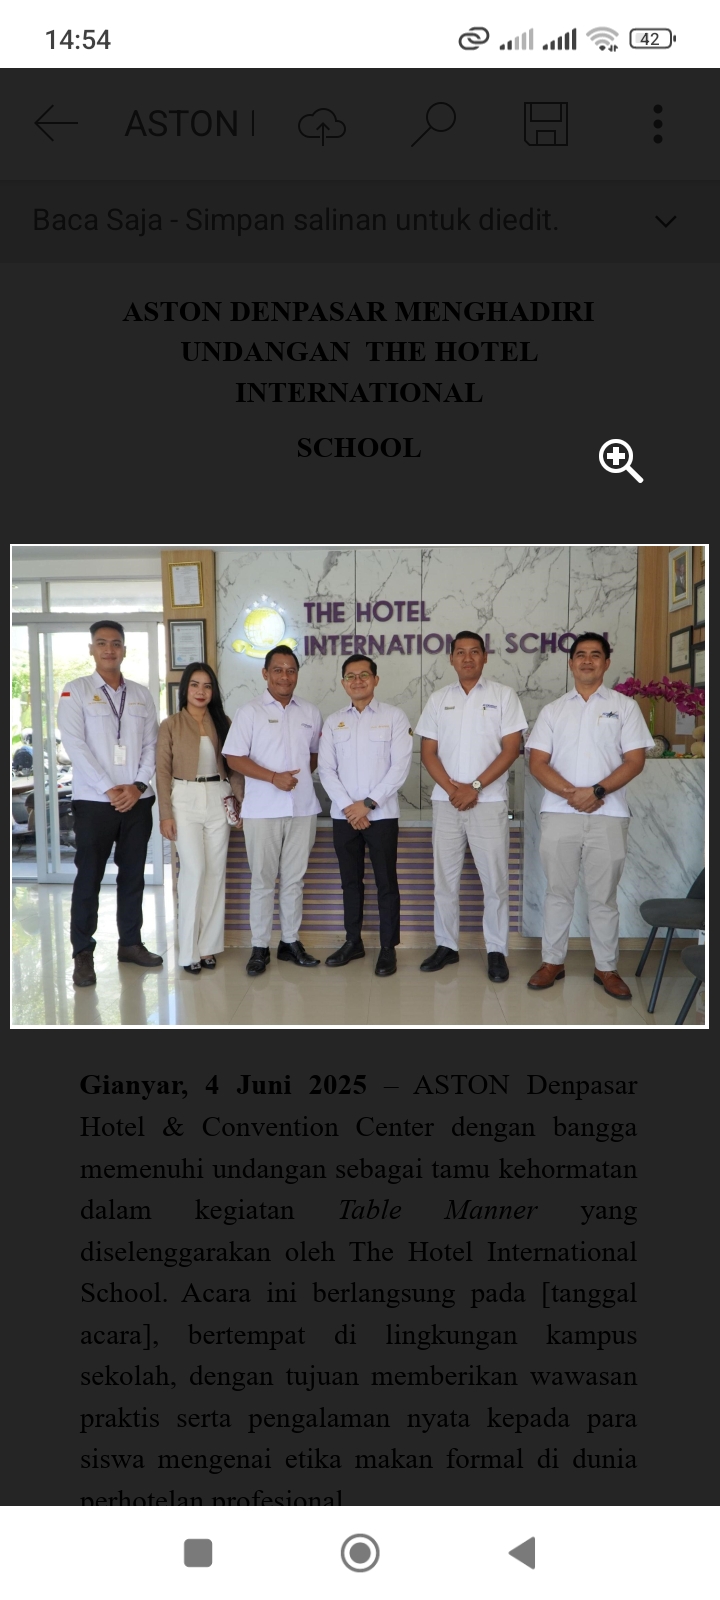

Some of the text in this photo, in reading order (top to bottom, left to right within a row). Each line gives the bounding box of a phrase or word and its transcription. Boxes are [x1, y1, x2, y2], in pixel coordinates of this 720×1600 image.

[45, 28, 112, 51] 14:54
[640, 32, 660, 46] 42
[124, 109, 238, 137] ASTON
[33, 208, 99, 231] Baca
[106, 207, 163, 237] Saja
[185, 207, 285, 237] Simpan
[293, 206, 387, 231] salinan
[396, 206, 472, 231] untuk
[478, 206, 558, 231] diedit.
[122, 301, 595, 322] ASTON DENPASAR MENGHADIRI
[180, 341, 539, 362] UNDANGAN THE HOTEL
[235, 382, 484, 403] INTERNATIONAL
[297, 437, 422, 458] SCHOOL
[303, 600, 431, 623] THE HOTEL
[303, 632, 496, 656] INTERNATIOL
[79, 1074, 189, 1101] Gianyar,
[204, 1074, 220, 1095] 4
[236, 1074, 293, 1095] Juni
[308, 1074, 367, 1095] 2025
[412, 1074, 511, 1095] ASTON
[526, 1074, 639, 1101] Denpasar
[79, 1115, 638, 1143] Hotel & Convention Center dengan bangga
[80, 1157, 638, 1185] memenuhi undangan sebagai tamu kehormatan
[80, 1198, 638, 1226] dalam kegiatan Table Manner yang
[80, 1240, 638, 1268] diselenggarakan oleh The Hotel International
[81, 1281, 638, 1309] School. Acara ini berlangsung pada [tanggal
[80, 1323, 638, 1351] acara], bertempat di lingkungan kampus
[80, 1364, 638, 1392] sekolah, dengan tujuan memberikan wawasan
[79, 1406, 638, 1434] praktis serta pengalaman nyata kepada para
[80, 1447, 638, 1475] siswa mengenai etika makan formal di dunia
